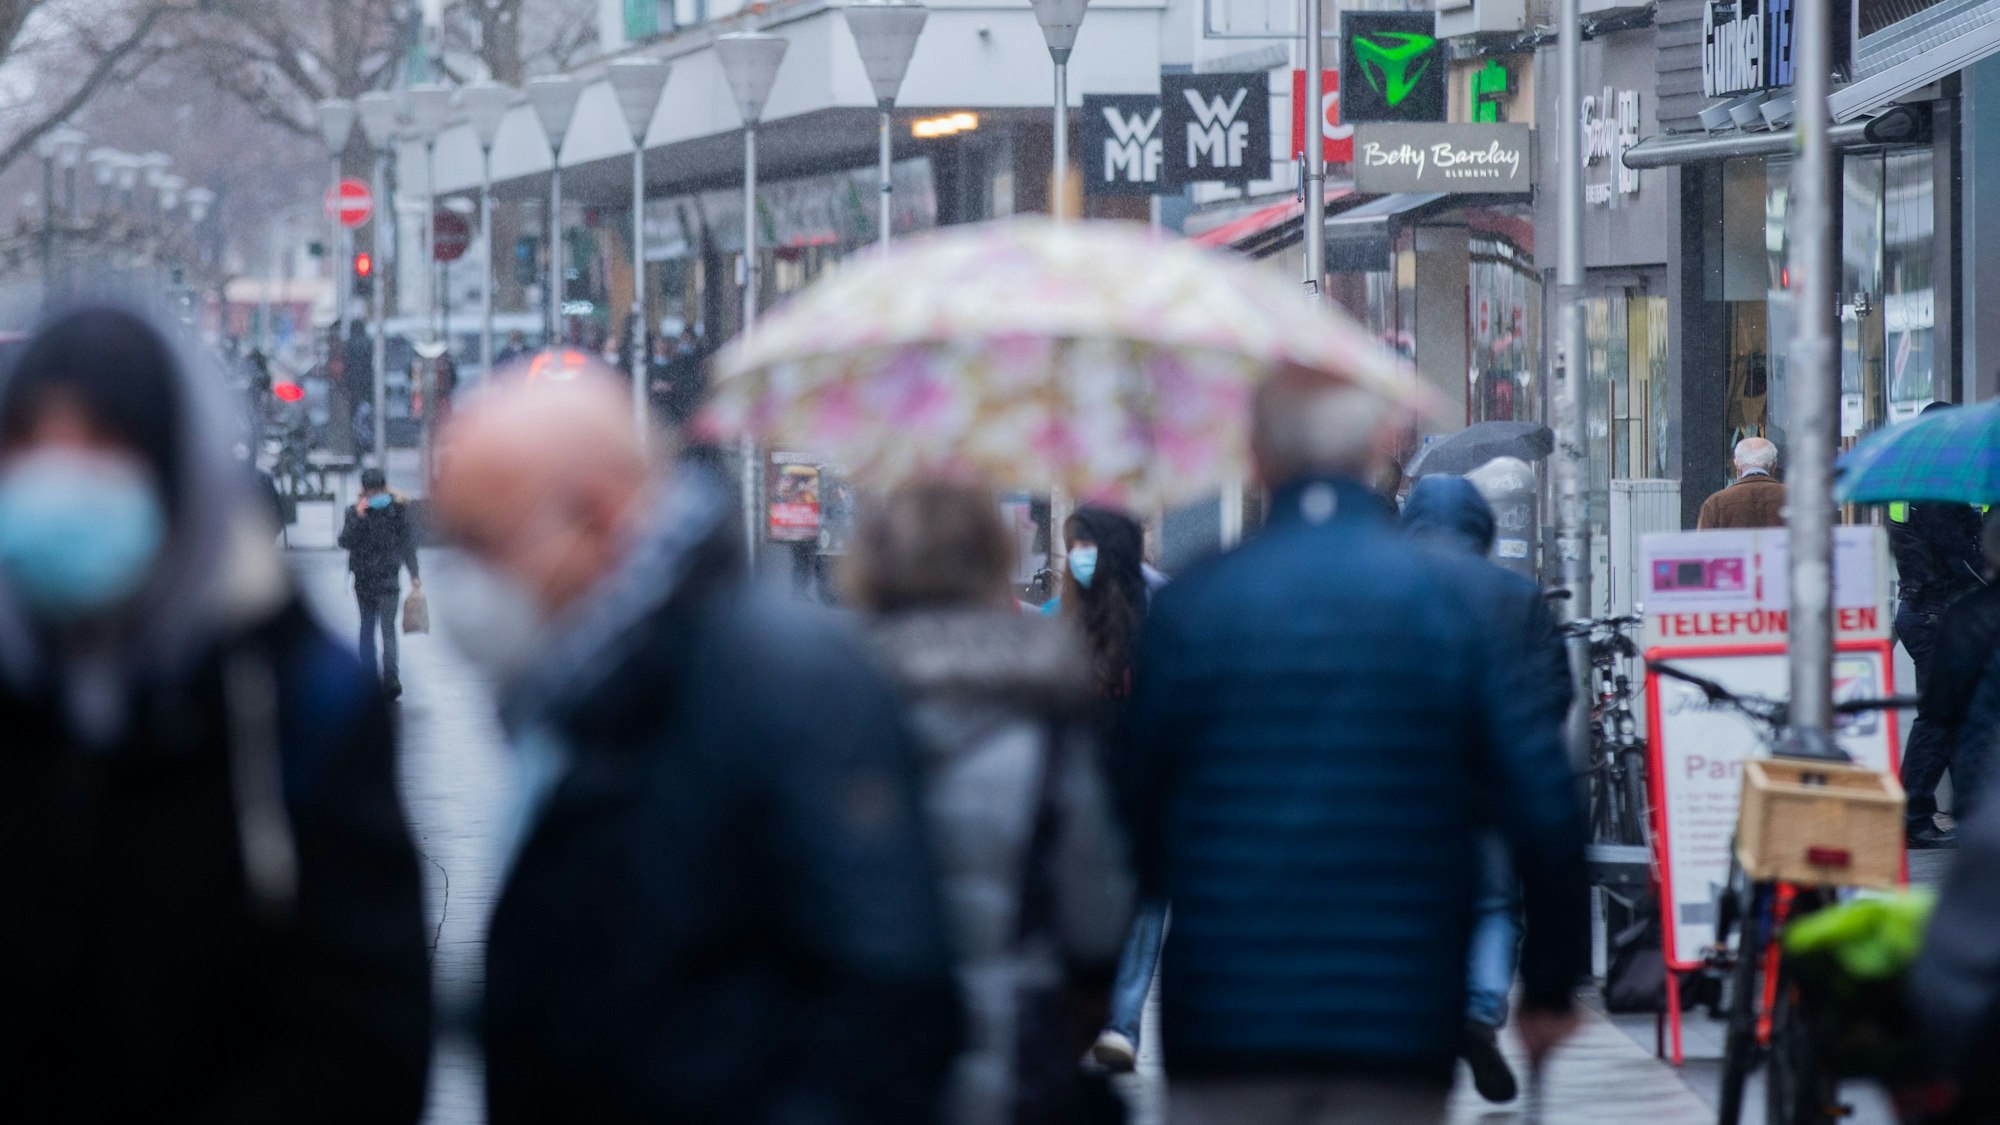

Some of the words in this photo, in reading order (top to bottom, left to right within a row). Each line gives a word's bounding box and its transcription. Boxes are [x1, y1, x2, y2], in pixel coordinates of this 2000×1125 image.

[1702, 0, 1763, 98] Gunkel
[1769, 0, 1798, 86] TEA
[1102, 106, 1163, 182] WMF
[1183, 87, 1249, 168] WMF
[1363, 142, 1425, 181] Betty
[1431, 139, 1520, 179] Barclay
[1445, 169, 1500, 178] ELEMENTS
[1658, 607, 1876, 636] TELEFONEN
